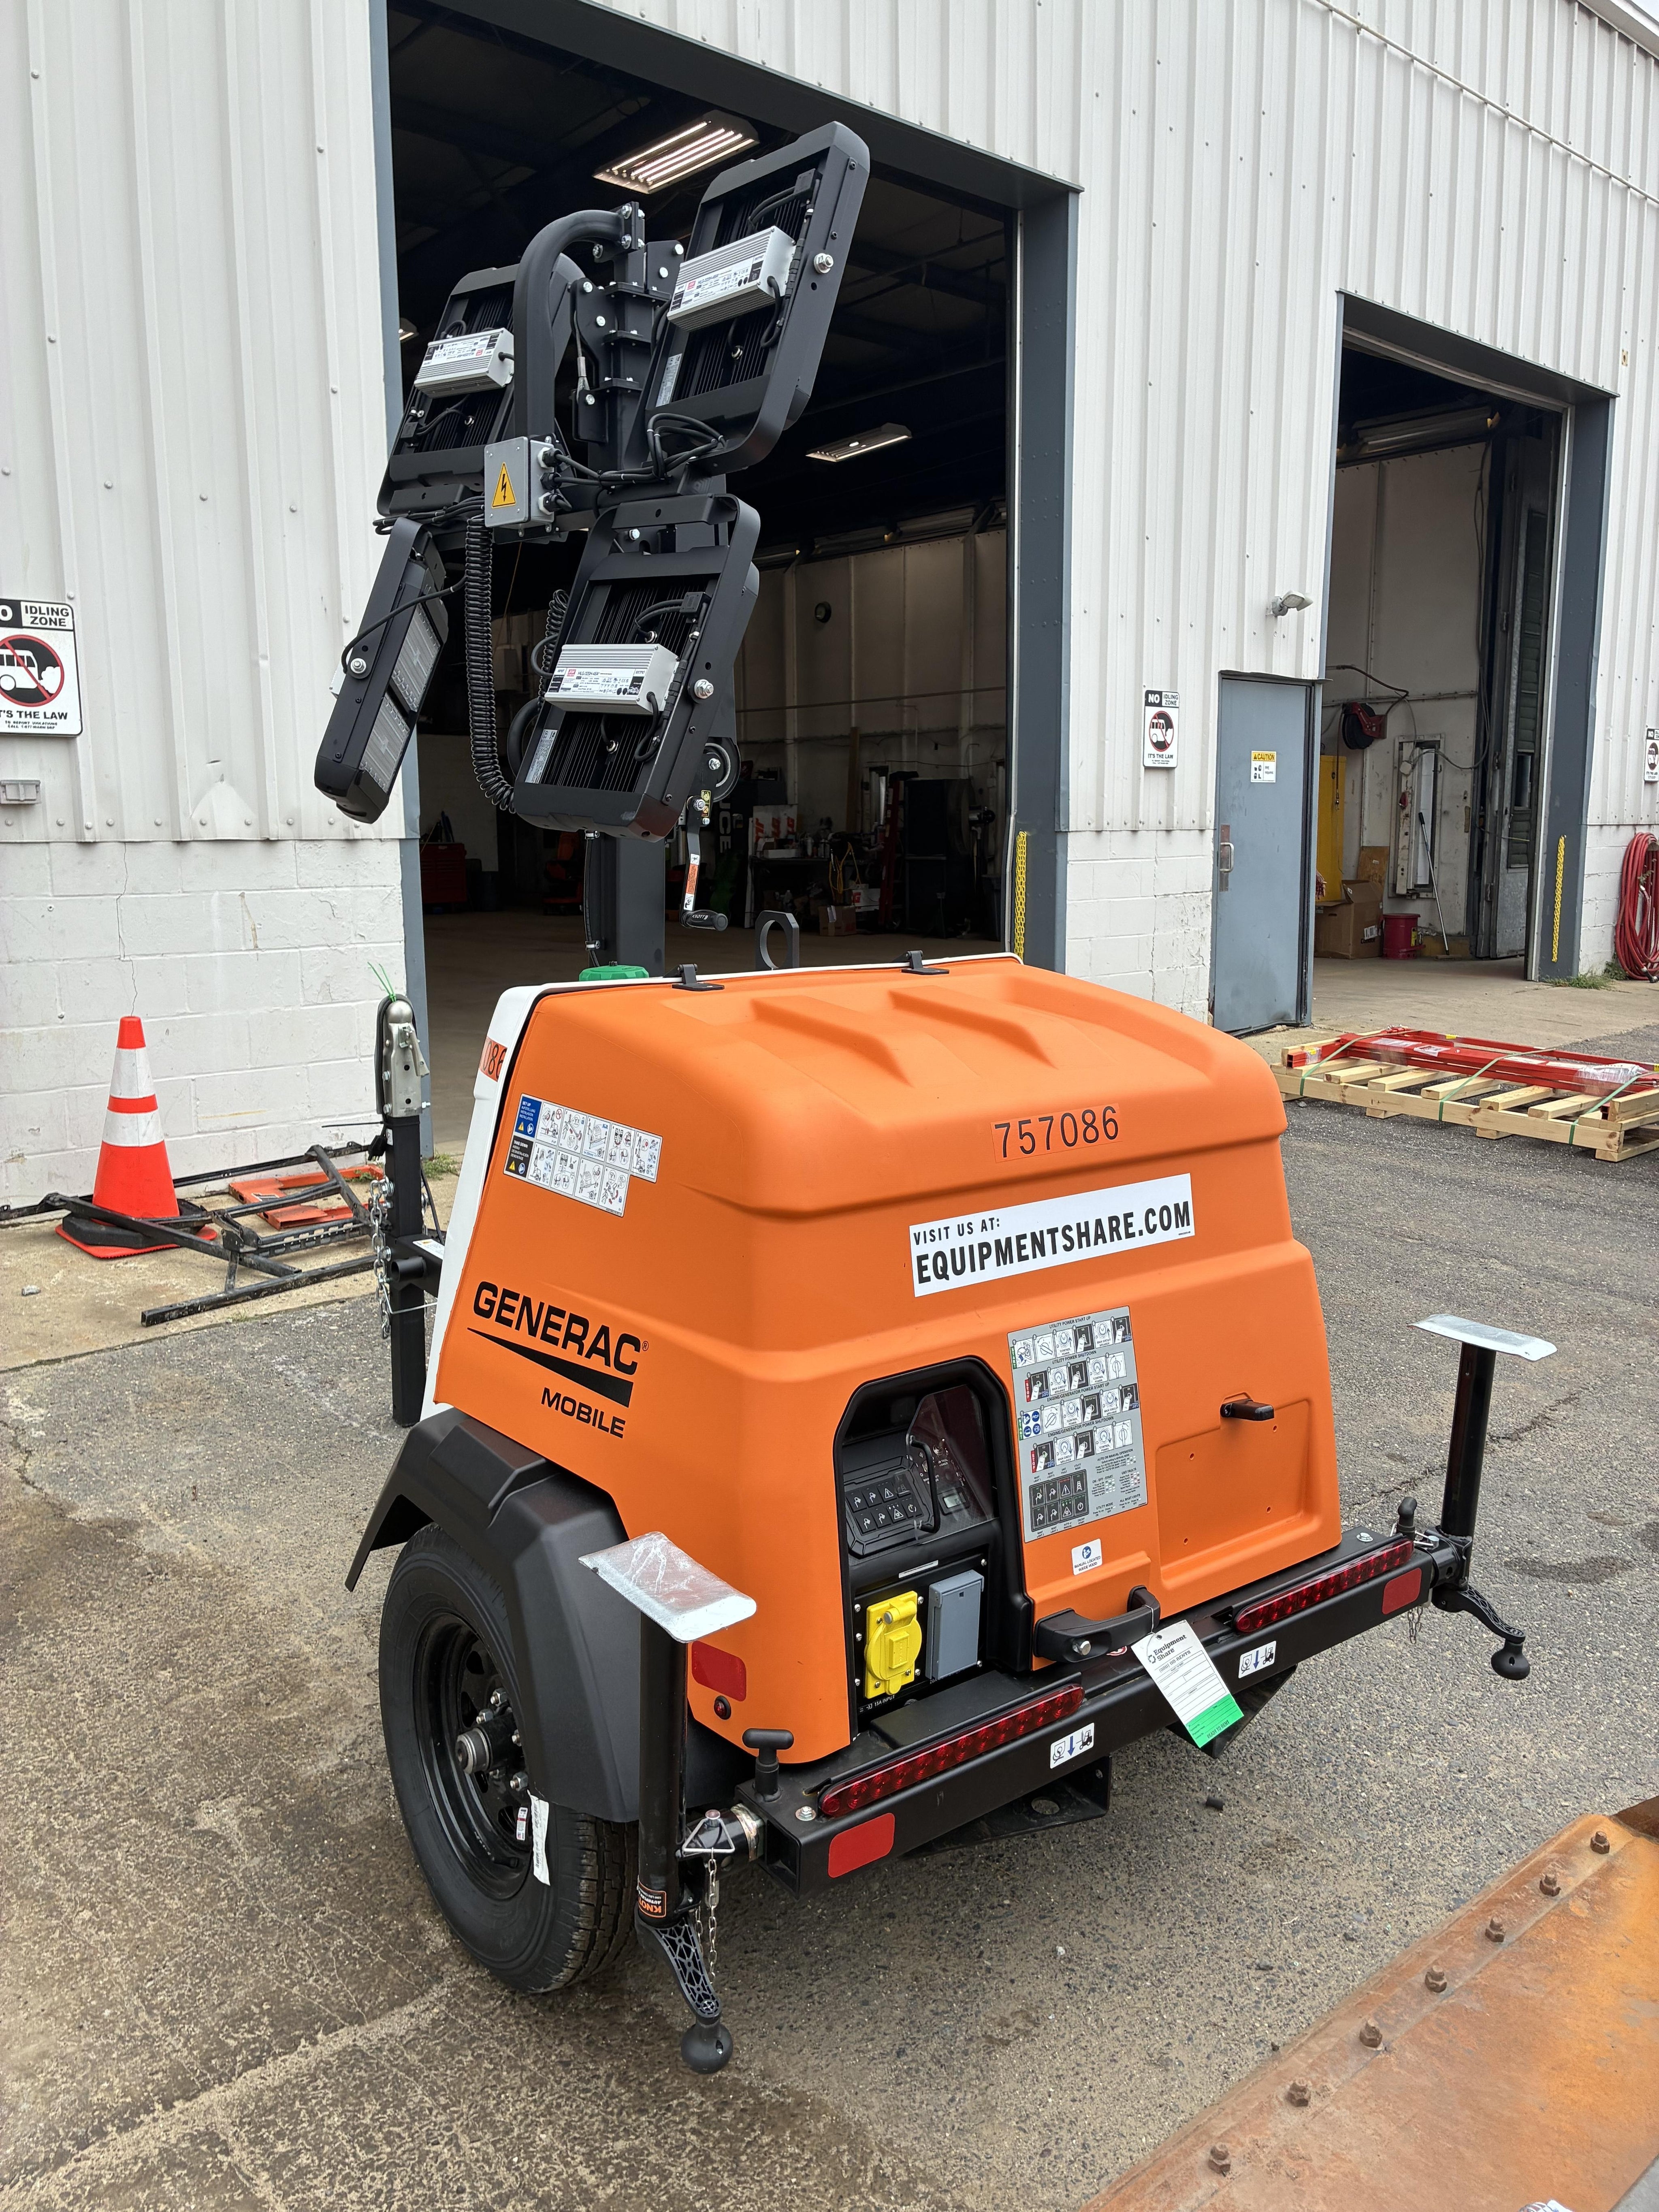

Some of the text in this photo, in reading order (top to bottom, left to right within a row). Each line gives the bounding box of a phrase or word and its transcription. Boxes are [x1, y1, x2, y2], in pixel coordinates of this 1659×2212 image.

[0, 605, 69, 621] O IDLING
[30, 616, 67, 627] ZONE
[1148, 693, 1160, 704] NO
[17, 710, 40, 719] THE
[43, 711, 68, 720] LAW
[994, 1105, 1119, 1158] 757086
[913, 1218, 1000, 1246] VISIT US AT:
[917, 1201, 1191, 1284] EQUIPMENTSHARE.COM
[1047, 1391, 1081, 1402] ENGINE/GENERATOR
[541, 1387, 626, 1439] MOBILE
[1048, 1425, 1082, 1437] ENGINE/GENERATOR
[1095, 1416, 1114, 1424] SHUTDOWN
[1153, 1634, 1187, 1656] Equipment
[1157, 1648, 1175, 1661] Share
[882, 1694, 895, 1703] INPUT
[1207, 1729, 1217, 1739] READY
[1220, 1719, 1230, 1729] RENT
